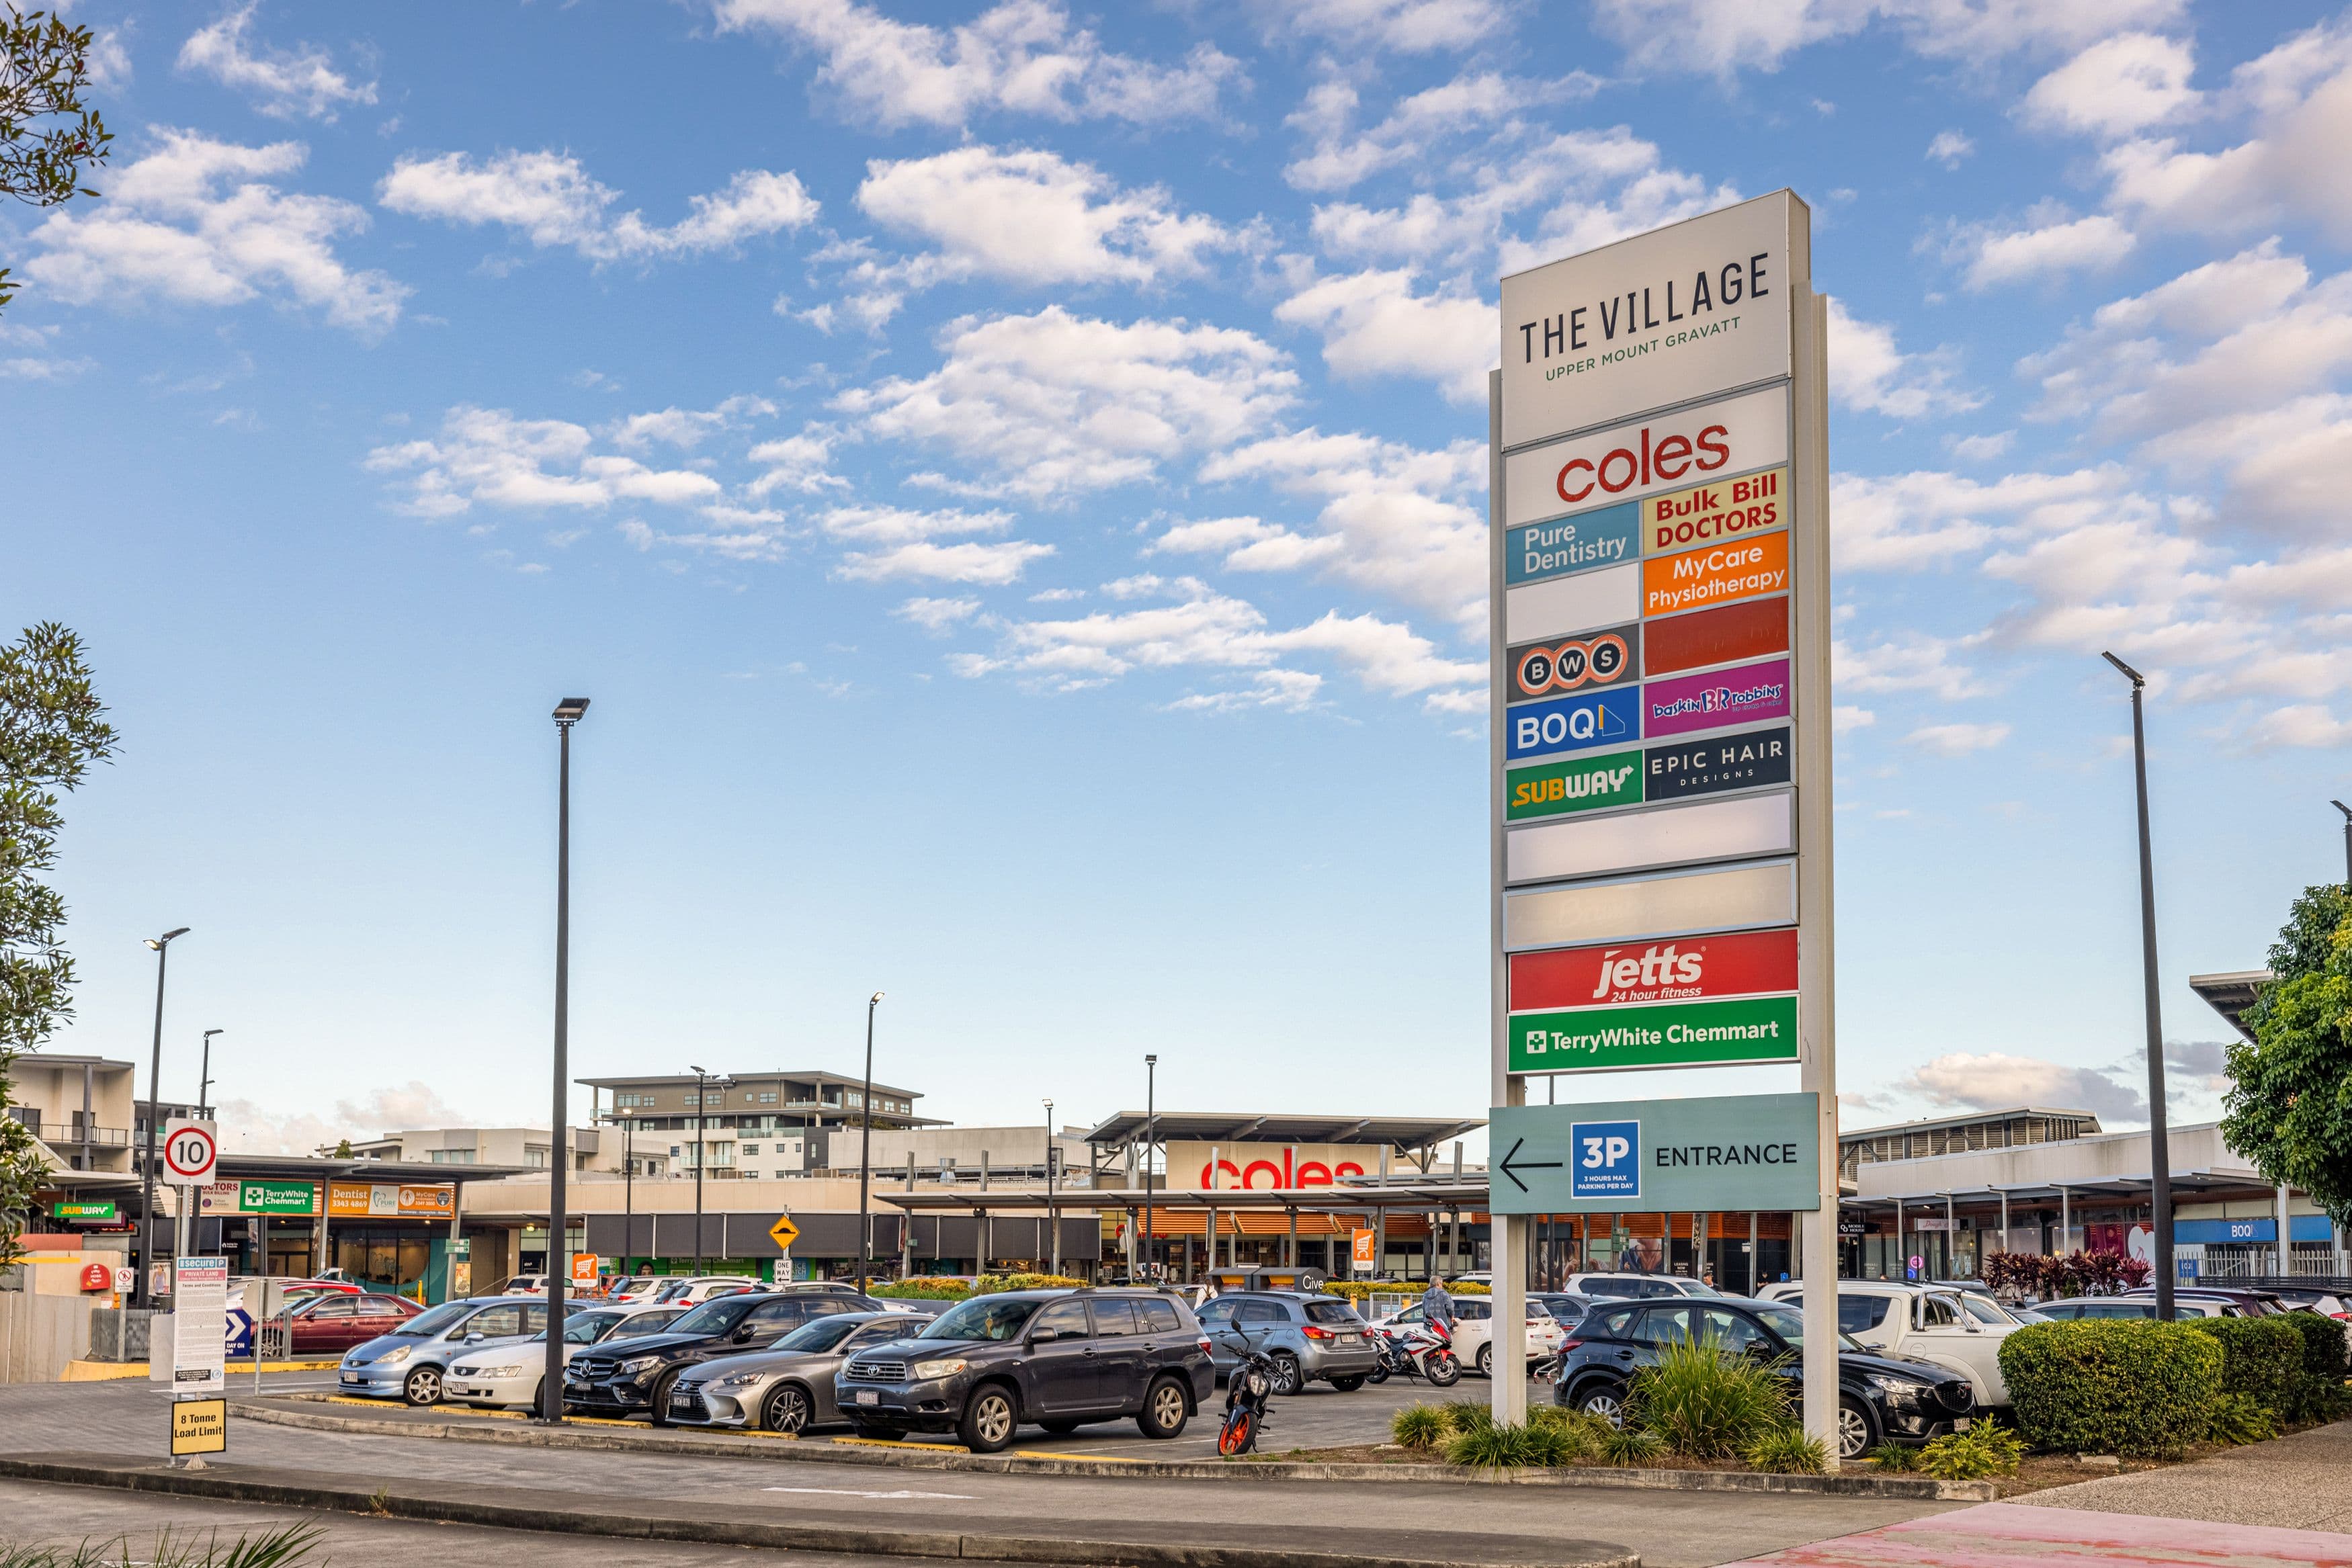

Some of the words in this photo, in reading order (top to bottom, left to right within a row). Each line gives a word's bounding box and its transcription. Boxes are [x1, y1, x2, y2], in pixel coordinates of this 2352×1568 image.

[1520, 306, 1587, 363] THE
[1600, 253, 1769, 341] VILLAGE
[1546, 357, 1595, 381] UPPER
[1602, 339, 1658, 366] MOUNT
[1665, 316, 1740, 347] GRAVATT
[1557, 425, 1729, 503] coles
[1656, 490, 1719, 522] Bulk
[1733, 473, 1777, 504] Bill
[1524, 524, 1577, 551] Pure
[1656, 502, 1777, 548] DOCTORS
[1525, 535, 1627, 574] Dentistry
[1673, 546, 1763, 579] MyCare
[1649, 569, 1785, 608] Physiotherapy
[1517, 708, 1595, 750] BOQ
[1652, 752, 1706, 775] EPIC
[1722, 740, 1783, 765] HAIR
[1512, 765, 1634, 808] SUBWAY
[1680, 769, 1753, 786] DESIGNS
[1593, 945, 1703, 998] jetts
[1611, 992, 1626, 1003] 24
[1629, 990, 1658, 1001] hour
[1661, 987, 1702, 998] fitness
[1551, 1028, 1662, 1053] TerryWhite
[1667, 1020, 1779, 1044] Chemmart
[178, 1140, 204, 1164] 10
[1582, 1137, 1630, 1169] 3P
[1656, 1143, 1798, 1167] ENTRANCE
[202, 1182, 238, 1190] OCTORS
[265, 1190, 308, 1199] TerryWhite
[333, 1188, 368, 1199] Dentist
[60, 1207, 108, 1215] SUBWAY
[2232, 1225, 2251, 1237] BOQ
[1302, 1274, 1324, 1291] Give
[175, 1428, 196, 1438] Load
[199, 1426, 222, 1436] Limit
[181, 1415, 187, 1424] 8
[190, 1414, 216, 1424] Tonne
